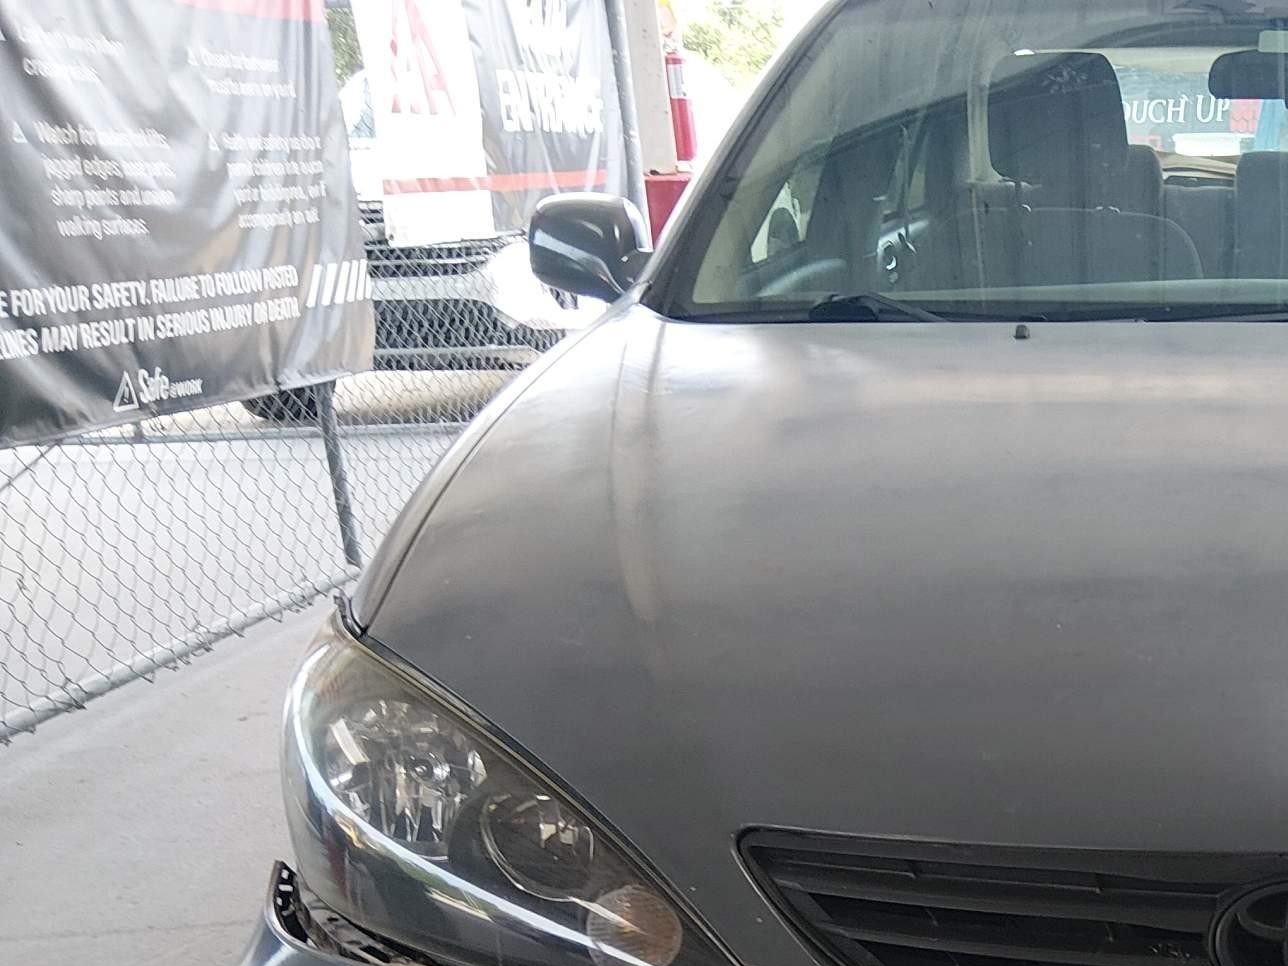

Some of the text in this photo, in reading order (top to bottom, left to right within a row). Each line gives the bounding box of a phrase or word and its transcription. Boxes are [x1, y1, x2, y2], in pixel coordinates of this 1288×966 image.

[10, 287, 47, 317] FOR
[45, 284, 91, 314] YOUR
[91, 280, 151, 310] SAFETY.
[150, 276, 201, 304] FAILURE
[198, 273, 216, 298] TO
[214, 269, 263, 297] FOLLOW
[262, 265, 299, 290] POSTED
[41, 324, 78, 353] MAY
[79, 317, 136, 349] RESULT
[136, 315, 156, 342] IN
[155, 309, 211, 340] SERIOUS
[208, 303, 253, 332] INJURY
[253, 301, 269, 325] OR
